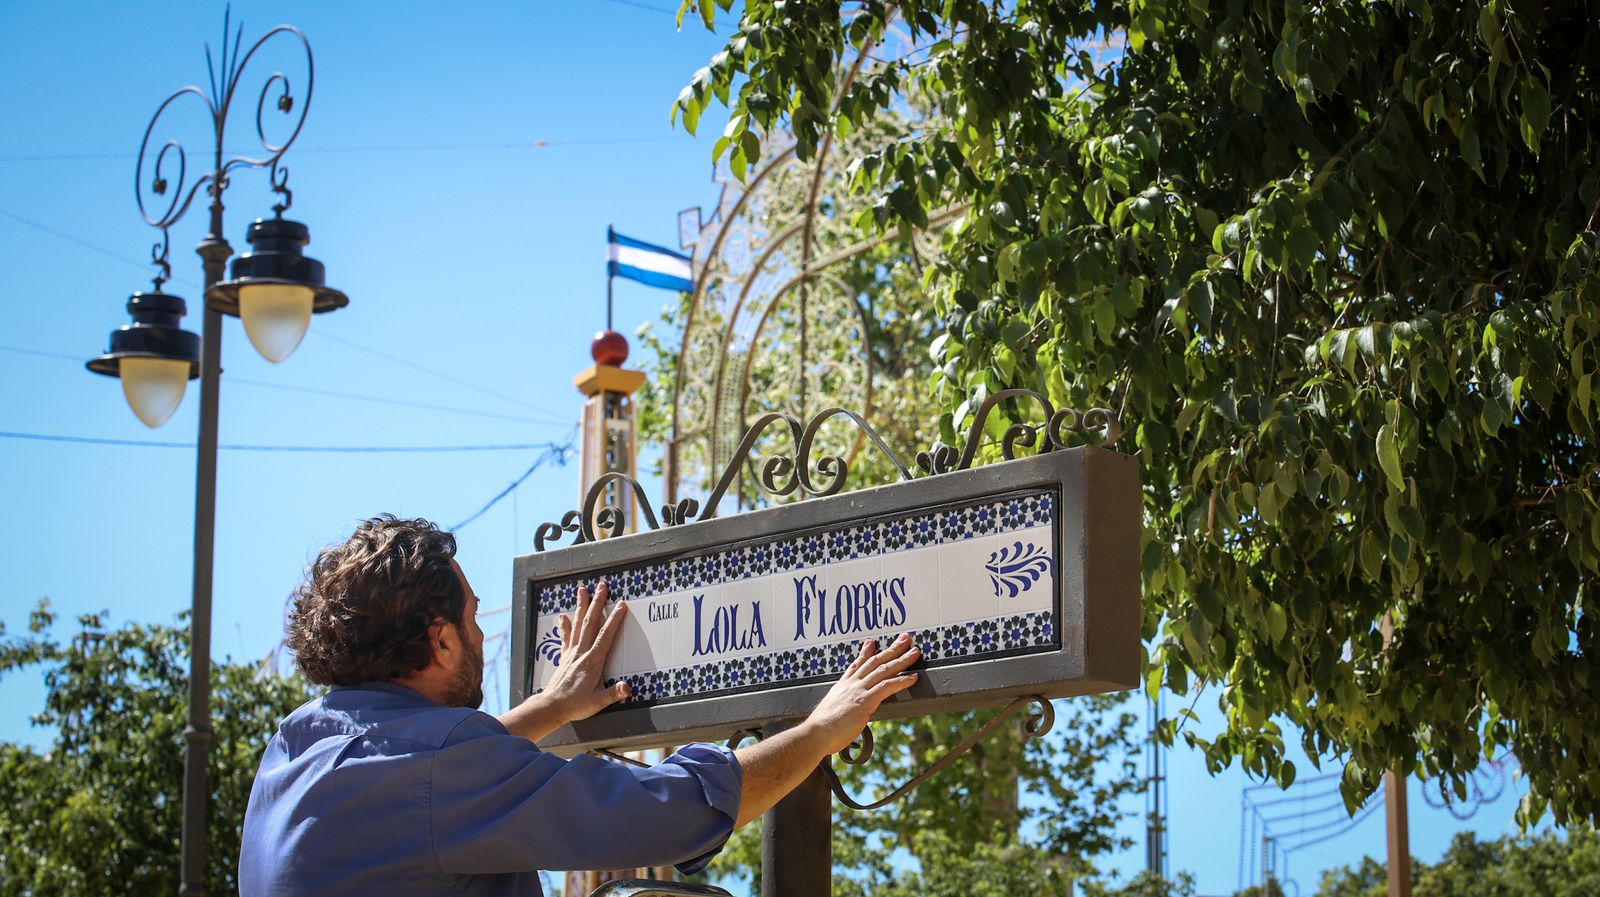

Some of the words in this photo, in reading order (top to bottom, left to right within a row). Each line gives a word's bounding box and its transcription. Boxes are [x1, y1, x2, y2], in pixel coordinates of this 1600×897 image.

[648, 602, 679, 622] CALLE
[692, 594, 766, 656] LOLA
[793, 575, 906, 641] FLORES
